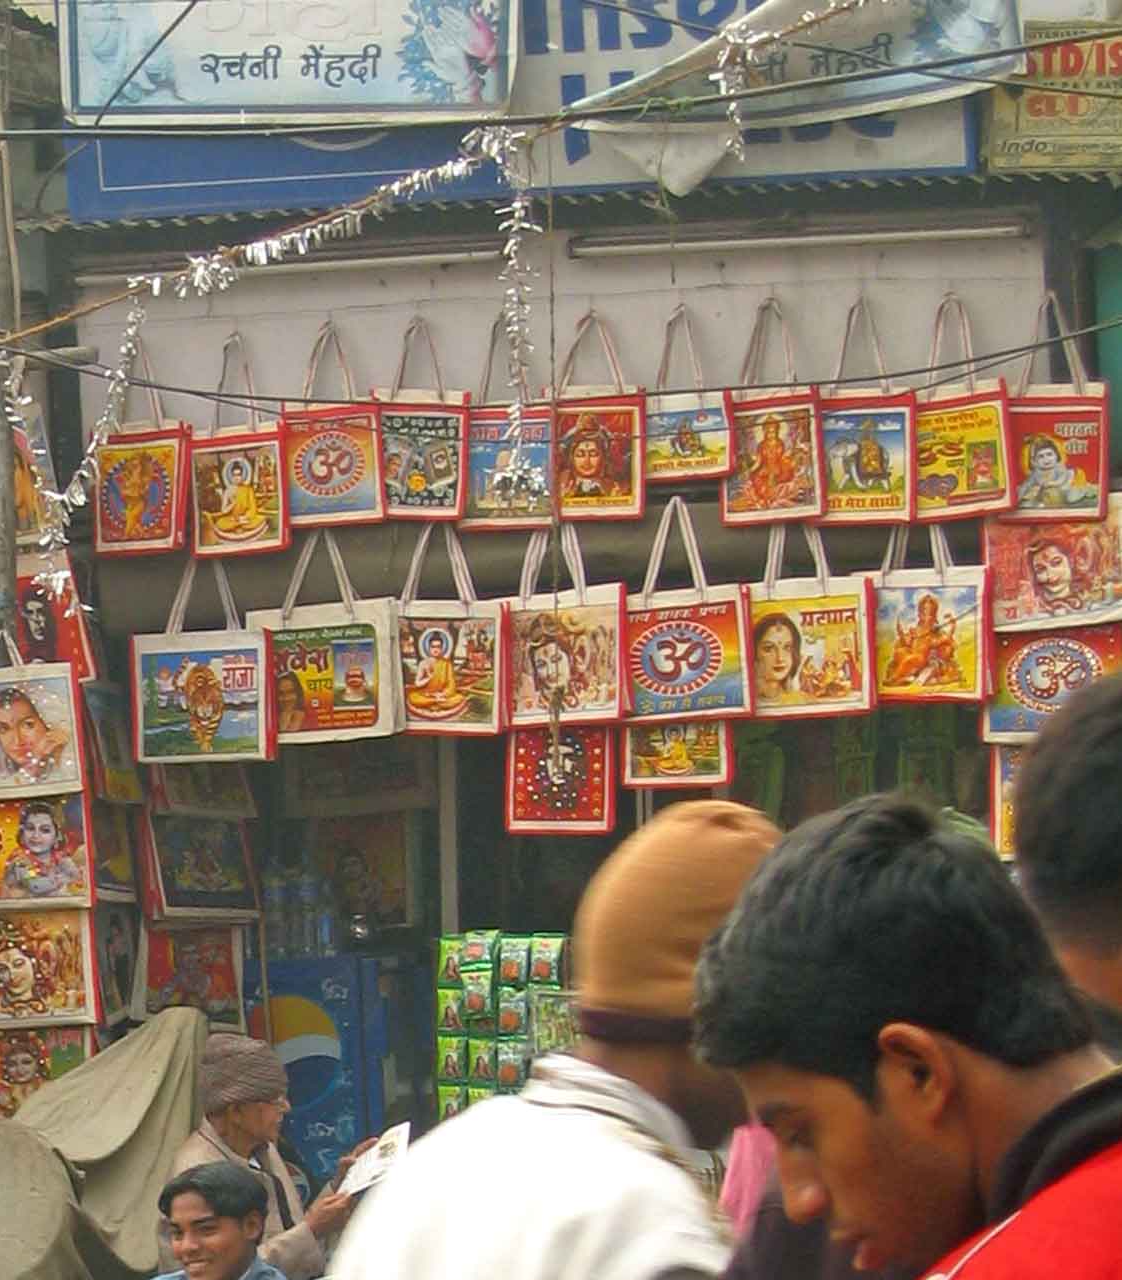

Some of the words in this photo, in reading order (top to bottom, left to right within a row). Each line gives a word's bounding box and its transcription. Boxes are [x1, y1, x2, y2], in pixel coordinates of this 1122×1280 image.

[200, 44, 282, 84] रचनी
[299, 44, 382, 88] मेंहदी
[1000, 139, 1048, 153] Indo
